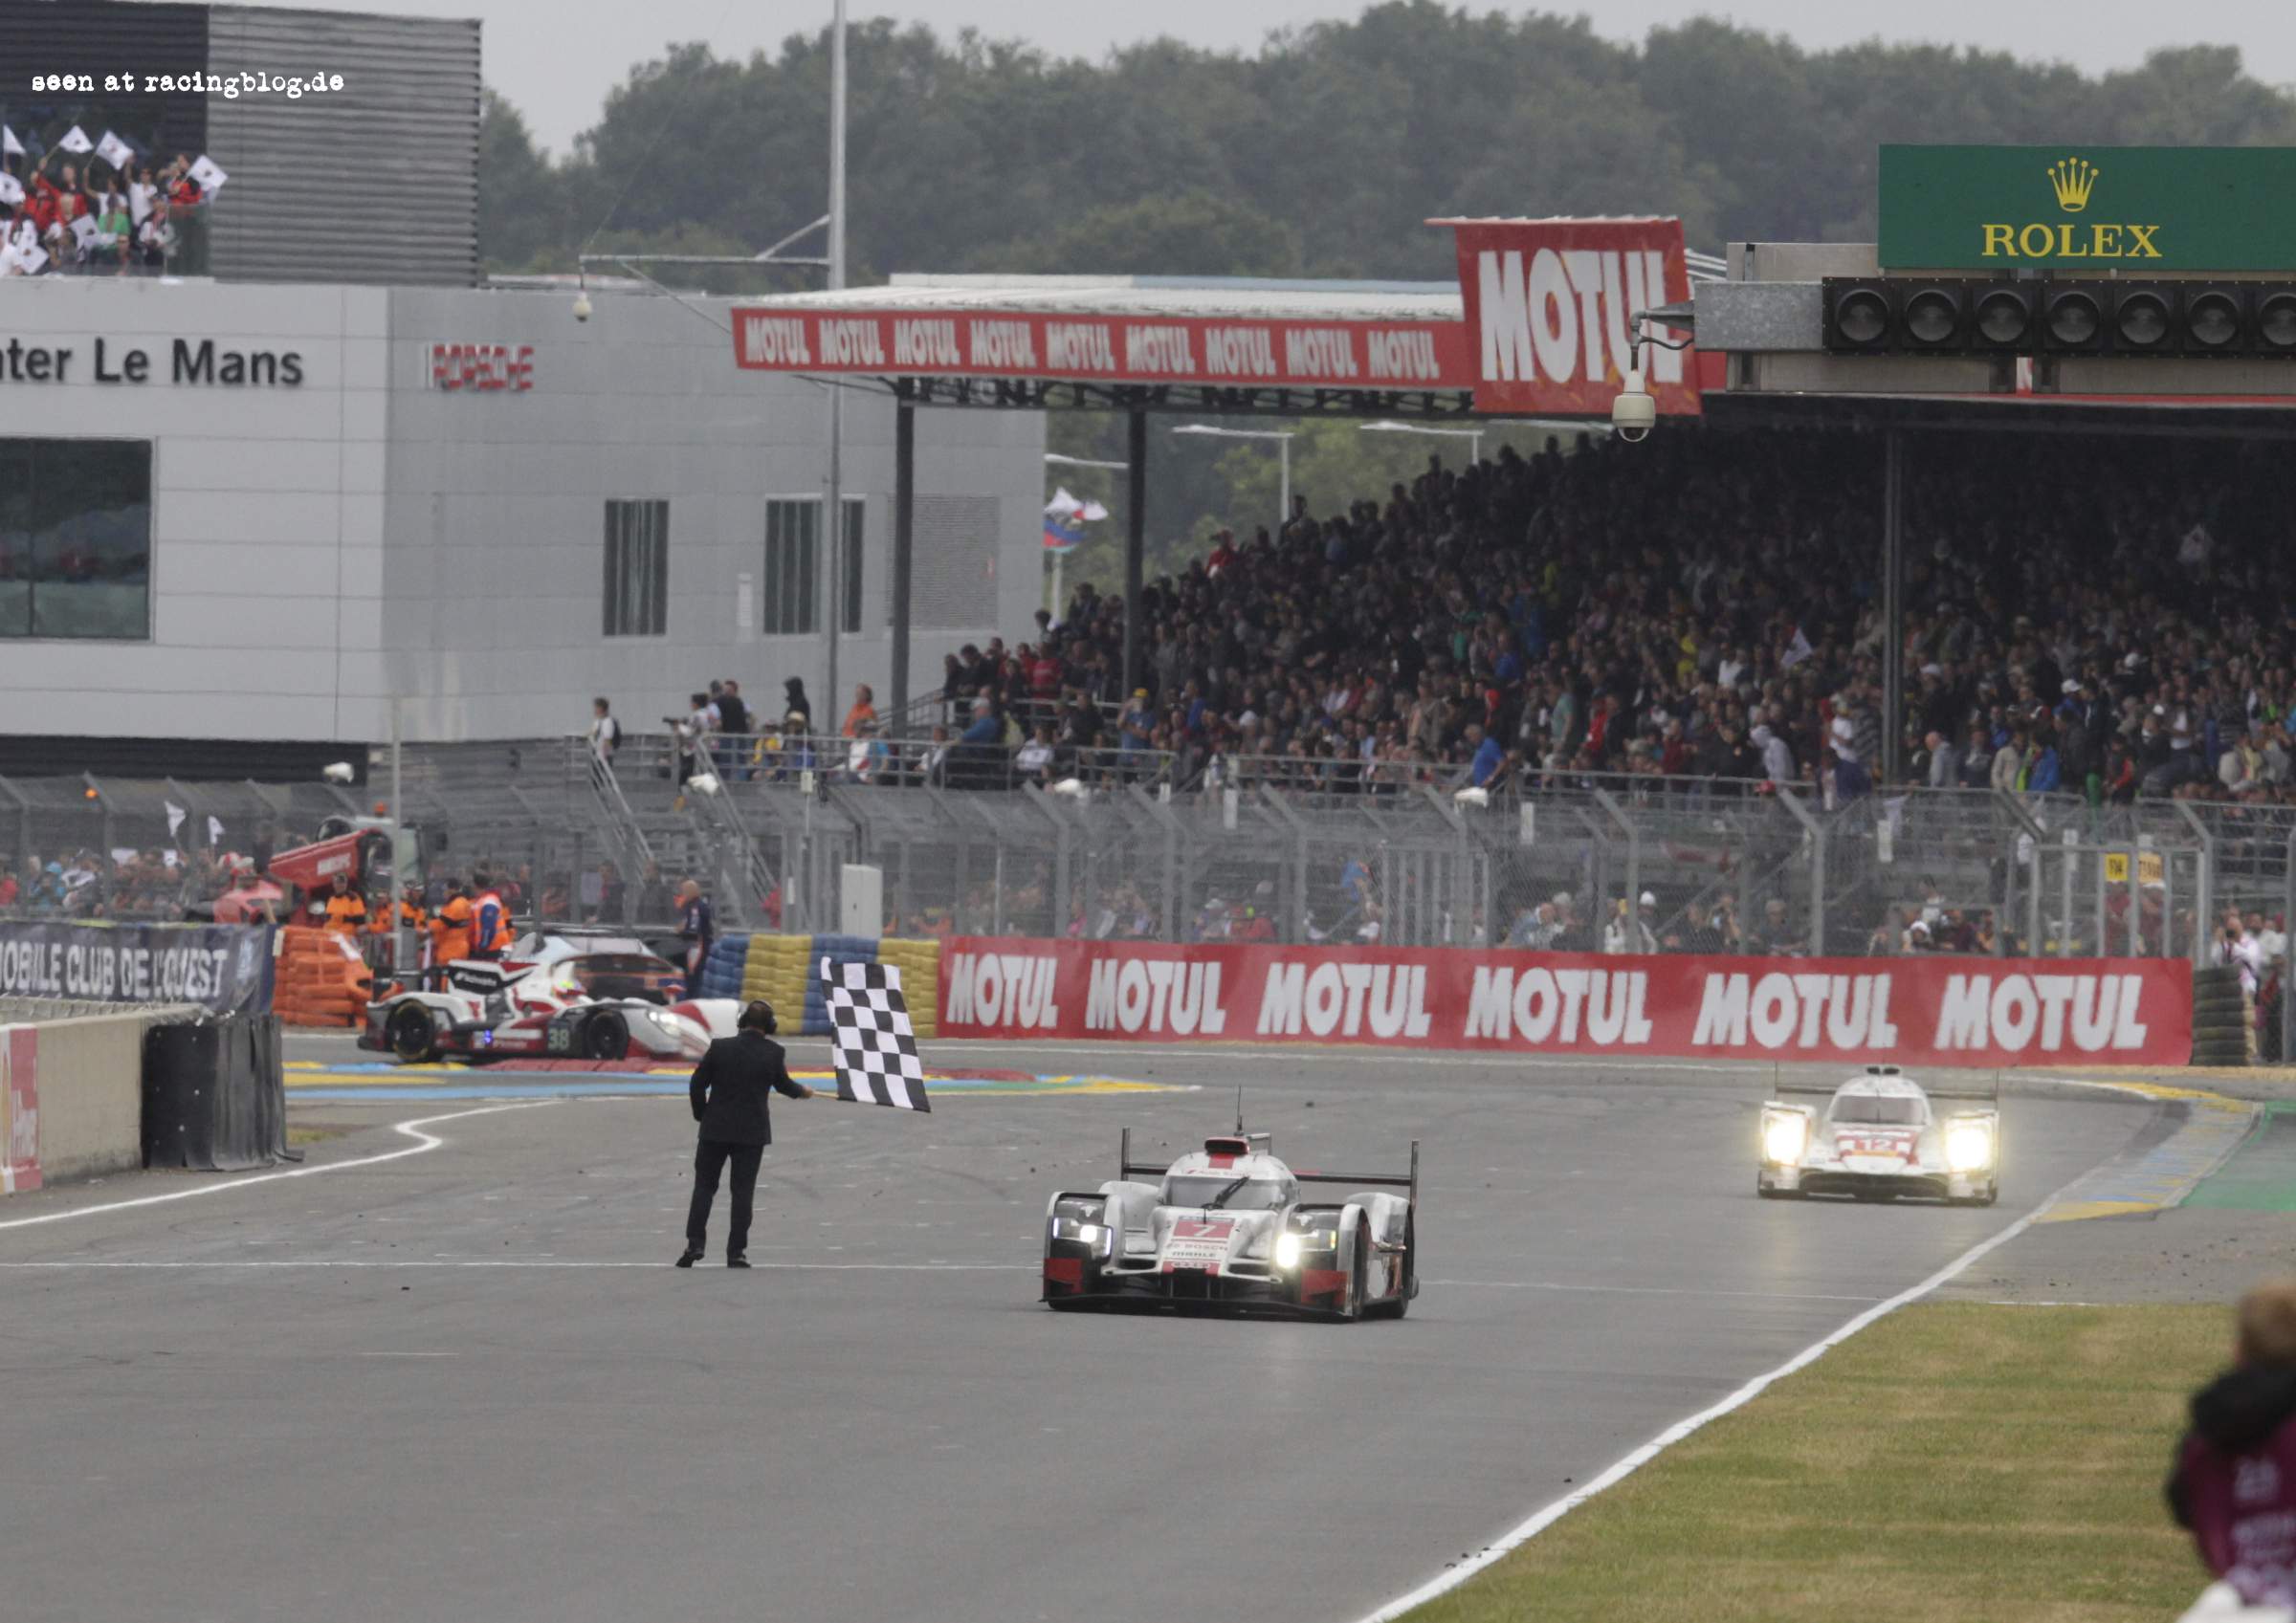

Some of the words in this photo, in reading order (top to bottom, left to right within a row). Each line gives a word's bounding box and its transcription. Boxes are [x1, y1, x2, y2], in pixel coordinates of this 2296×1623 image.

[1982, 224, 2162, 258] ROLEX
[1478, 247, 1683, 383] MOTUL
[0, 338, 73, 383] ter
[95, 337, 149, 384] Le
[172, 338, 303, 385] Mans
[745, 318, 810, 364] MOTUL
[820, 318, 885, 365] MOTUL
[894, 319, 960, 365] MOTUL
[971, 320, 1037, 367] MOTUL
[1047, 322, 1115, 370] MOTUL
[1126, 324, 1195, 373] MOTUL
[1205, 327, 1276, 375] MOTUL
[1286, 328, 1358, 377] MOTUL
[1368, 331, 1440, 379] MOTUL
[67, 944, 114, 995] CLUB
[121, 948, 149, 997] DE
[946, 954, 1059, 1027] MOTUL
[1085, 958, 1226, 1034] MOTUL
[1256, 962, 1431, 1038] MOTUL
[1464, 966, 1653, 1046] MOTUL
[1690, 972, 1899, 1049] MOTUL
[1934, 974, 2148, 1051] MOTUL
[547, 1027, 570, 1050] 38
